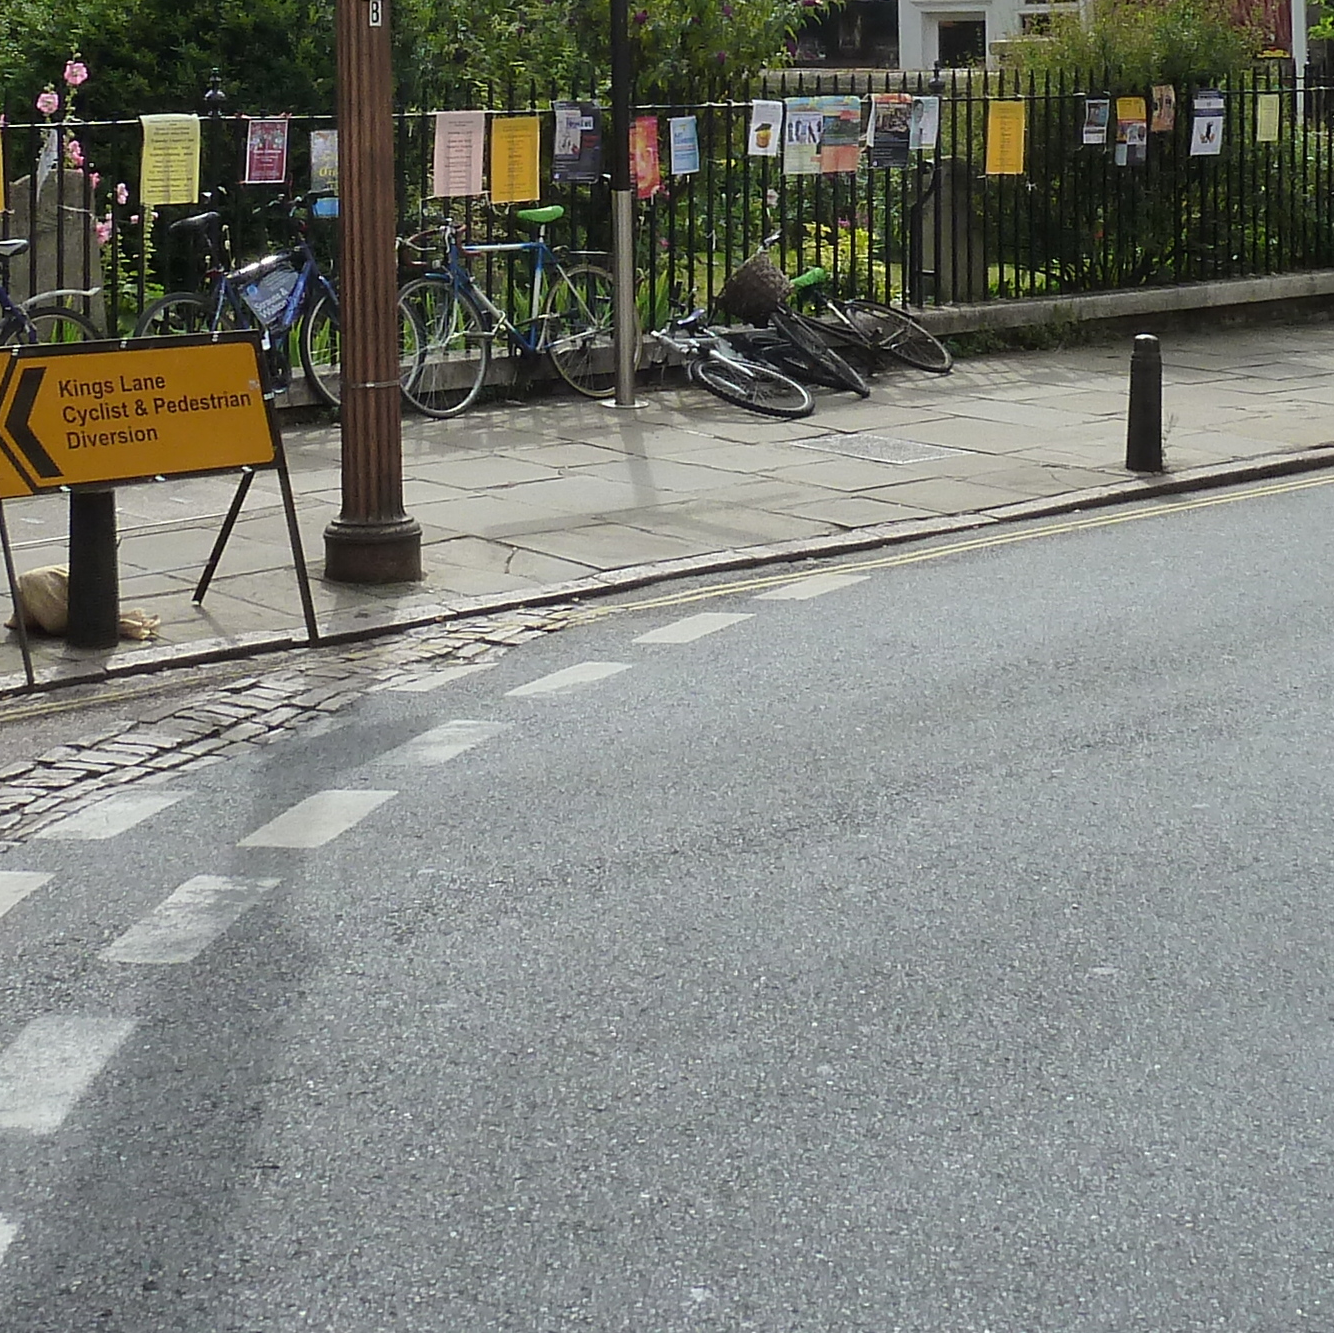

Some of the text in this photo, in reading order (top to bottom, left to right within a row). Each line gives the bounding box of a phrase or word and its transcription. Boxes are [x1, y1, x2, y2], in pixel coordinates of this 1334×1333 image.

[58, 375, 166, 399] Kings Lane
[62, 391, 251, 426] Cyclist & Pedestrian
[66, 426, 158, 450] Diversion
